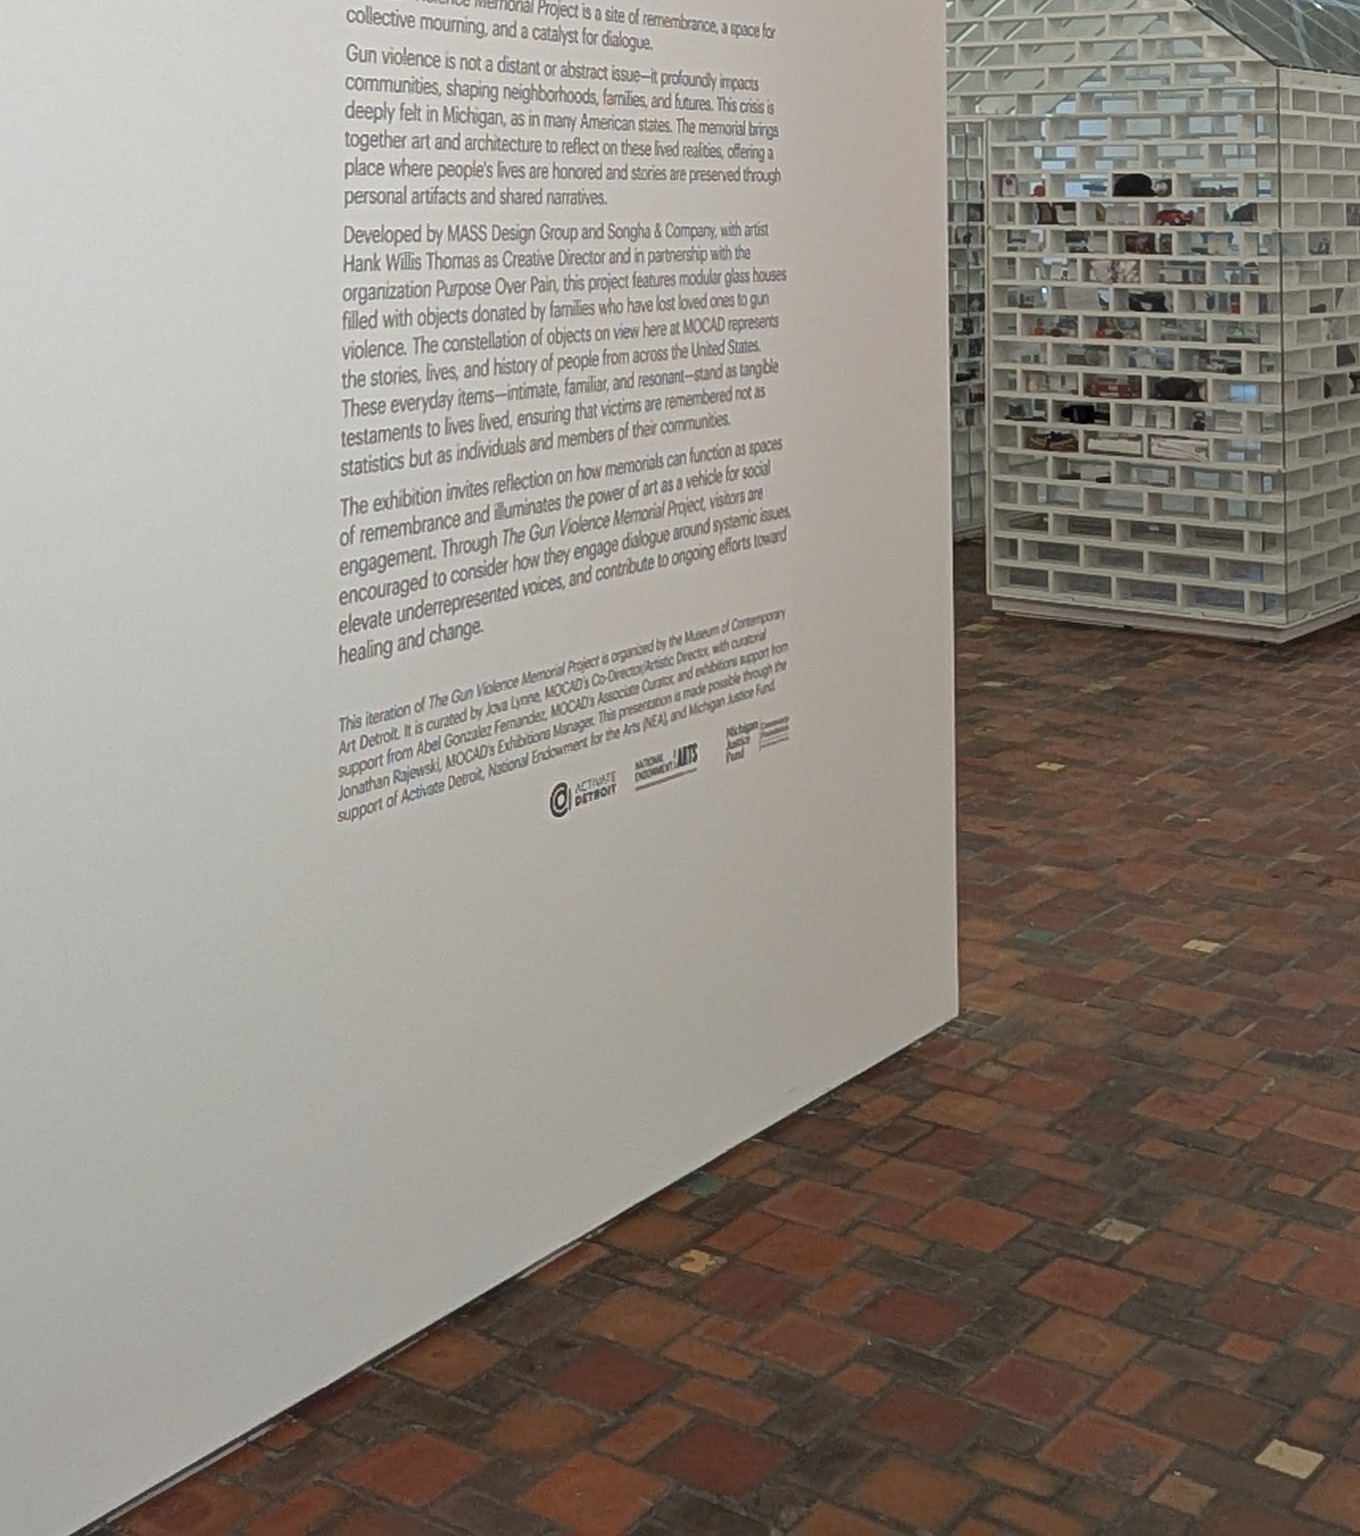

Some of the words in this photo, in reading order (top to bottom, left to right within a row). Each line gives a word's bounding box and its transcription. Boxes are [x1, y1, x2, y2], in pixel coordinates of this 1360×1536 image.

[346, 6, 415, 29] collective
[419, 15, 488, 40] mourning,
[491, 20, 517, 39] and
[531, 24, 578, 47] catalyst
[581, 27, 598, 46] for
[581, 2, 591, 21] is
[604, 5, 625, 24] site
[627, 7, 640, 26] of
[730, 23, 760, 40] space
[762, 22, 775, 40] for
[346, 43, 377, 64] Gun
[381, 46, 441, 69] violence
[444, 55, 456, 70] is
[459, 56, 481, 72] not
[496, 55, 540, 77] distant
[543, 63, 557, 78] or
[344, 75, 441, 98] communities,
[445, 77, 498, 104] shaping
[344, 100, 395, 125] deeply
[399, 102, 421, 122] felt
[425, 103, 438, 123] in
[442, 104, 506, 130] Michigan,
[510, 112, 525, 127] as
[528, 109, 540, 127] in
[344, 129, 407, 153] together
[410, 133, 430, 151] art
[434, 132, 460, 151] and
[464, 133, 542, 154] architecture
[545, 138, 558, 154] to
[344, 156, 385, 180] place
[388, 157, 433, 178] where
[436, 159, 493, 182] people's
[496, 159, 525, 180] lives
[528, 165, 548, 180] are
[344, 185, 407, 209] personal
[411, 185, 466, 205] artifacts
[469, 186, 495, 205] and
[499, 186, 542, 206] shared
[343, 223, 421, 248] Developed
[426, 223, 443, 247] by
[447, 223, 487, 243] MASS
[491, 223, 535, 246] Design
[343, 251, 381, 273] Hank
[385, 250, 421, 272] Willis
[425, 250, 480, 270] Thomas
[483, 253, 499, 269] as
[501, 249, 554, 269] Creative
[342, 279, 431, 307] organization
[435, 279, 491, 301] Purpose
[494, 276, 526, 296] Over
[530, 274, 559, 296] Pain,
[342, 308, 378, 330] filled
[382, 307, 412, 328] with
[416, 305, 468, 330] objects
[471, 301, 526, 324] donated
[530, 300, 546, 324] by
[341, 337, 407, 361] violence.
[412, 334, 438, 355] The
[442, 329, 526, 354] constellation
[530, 326, 543, 347] of
[341, 368, 366, 391] the
[370, 365, 421, 388] stories,
[425, 362, 459, 383] lives,
[463, 357, 489, 380] and
[493, 356, 537, 377] history
[540, 352, 553, 373] of
[341, 397, 386, 419] These
[390, 389, 453, 415] everyday
[340, 422, 422, 448] testaments
[426, 421, 440, 438] to
[444, 415, 474, 436] lives
[478, 409, 512, 431] lived,
[340, 451, 404, 478] statistics
[408, 447, 432, 469] but
[436, 448, 452, 465] as
[456, 434, 526, 462] individuals
[529, 430, 553, 453] and
[340, 495, 368, 517] The
[372, 486, 442, 513] exhibition
[446, 479, 489, 502] invites
[492, 470, 553, 495] reflection
[339, 523, 355, 547] of
[359, 513, 461, 544] remembrance
[464, 503, 490, 527] and
[493, 497, 561, 521] illuminates
[339, 543, 436, 578] engagement.
[441, 529, 497, 558] Through
[502, 526, 525, 547] The
[528, 522, 555, 542] Gun
[338, 569, 428, 606] encouraged
[432, 570, 447, 589] to
[450, 556, 508, 585] consider
[512, 552, 540, 572] how
[338, 610, 391, 636] elevate
[396, 579, 518, 624] underrepresented
[338, 638, 393, 665] healing
[397, 626, 425, 652] and
[428, 620, 483, 645] change.
[365, 704, 411, 728] iteration
[425, 706, 467, 733] curated
[338, 753, 383, 779] support
[386, 746, 413, 765] from
[337, 797, 383, 823] support
[400, 780, 444, 805] Activate
[338, 775, 390, 801] Jonathan
[575, 783, 617, 806] DETROIT
